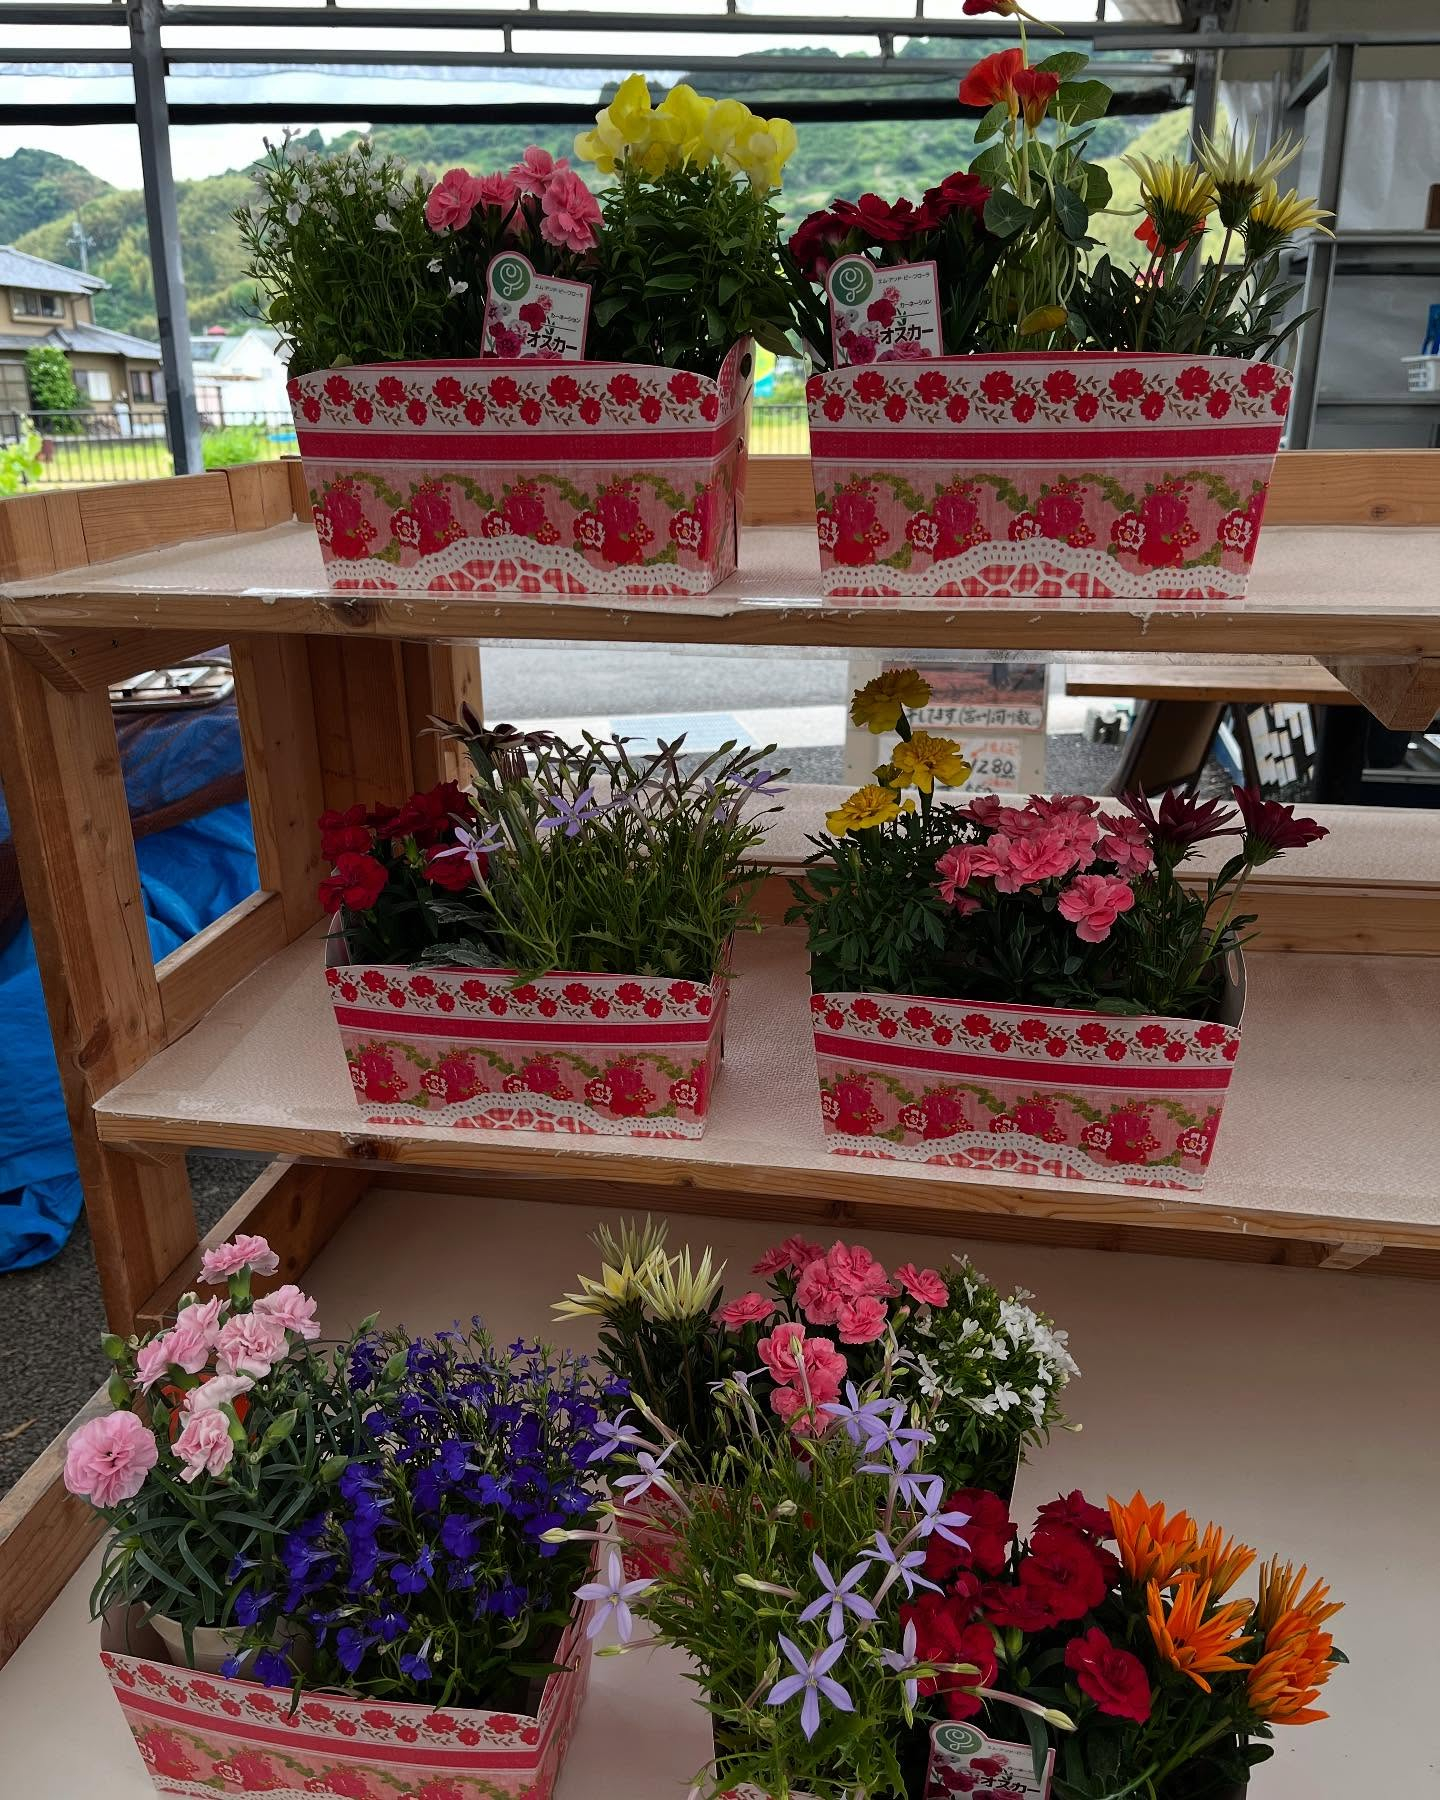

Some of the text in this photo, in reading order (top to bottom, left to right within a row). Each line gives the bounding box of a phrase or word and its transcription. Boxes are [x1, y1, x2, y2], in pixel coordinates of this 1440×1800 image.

[900, 299, 932, 309] カーネーション
[550, 312, 581, 324] カーネーション
[526, 332, 578, 353] オスカー
[880, 324, 934, 345] オスカー
[980, 1775, 1041, 1794] オスカー
